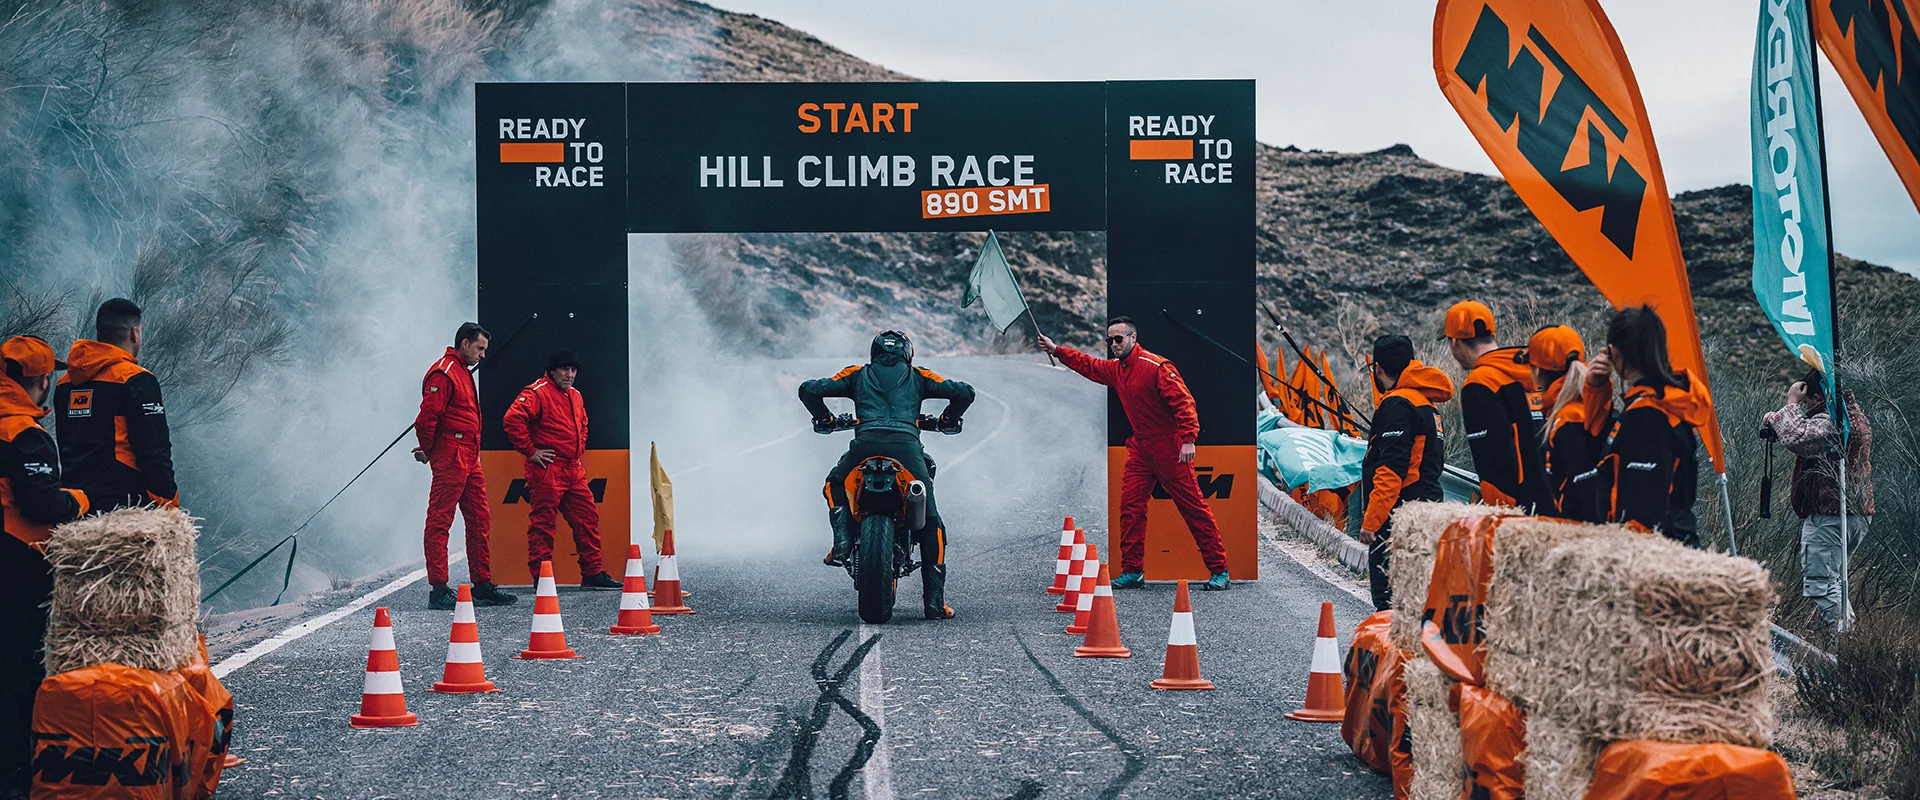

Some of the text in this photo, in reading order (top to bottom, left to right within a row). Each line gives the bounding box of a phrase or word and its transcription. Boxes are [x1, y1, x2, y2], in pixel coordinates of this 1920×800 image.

[499, 118, 587, 140] READY
[797, 102, 919, 134] START
[1129, 114, 1216, 137] READY
[569, 141, 604, 163] TO
[1199, 138, 1233, 160] TO
[535, 166, 604, 187] RACE
[700, 154, 1035, 188] HILL CLIMB RACE
[1165, 162, 1233, 184] RACE
[926, 187, 1046, 215] 890 SMT
